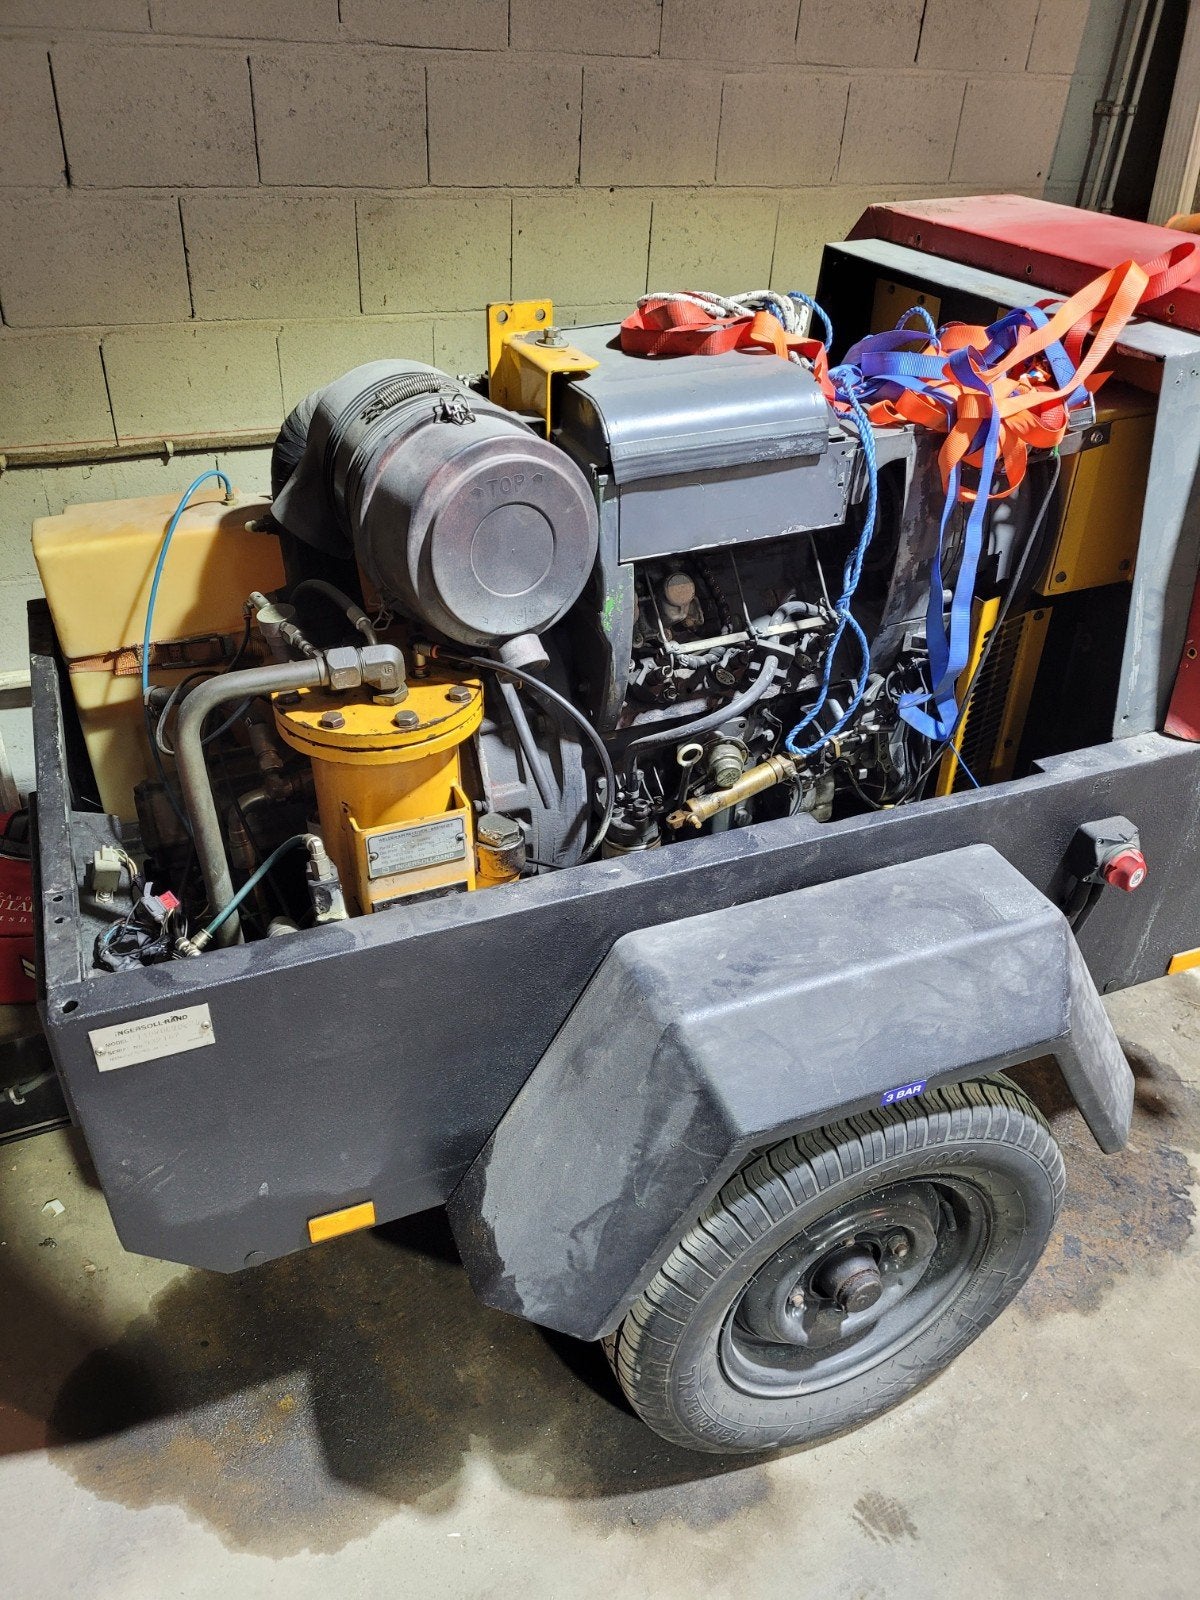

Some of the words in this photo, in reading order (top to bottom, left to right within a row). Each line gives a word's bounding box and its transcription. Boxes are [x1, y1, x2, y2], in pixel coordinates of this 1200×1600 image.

[485, 473, 525, 498] TOP
[114, 1013, 189, 1038] INGERSOLL-RAND
[885, 1093, 894, 1102] 3
[896, 1085, 922, 1099] BAR
